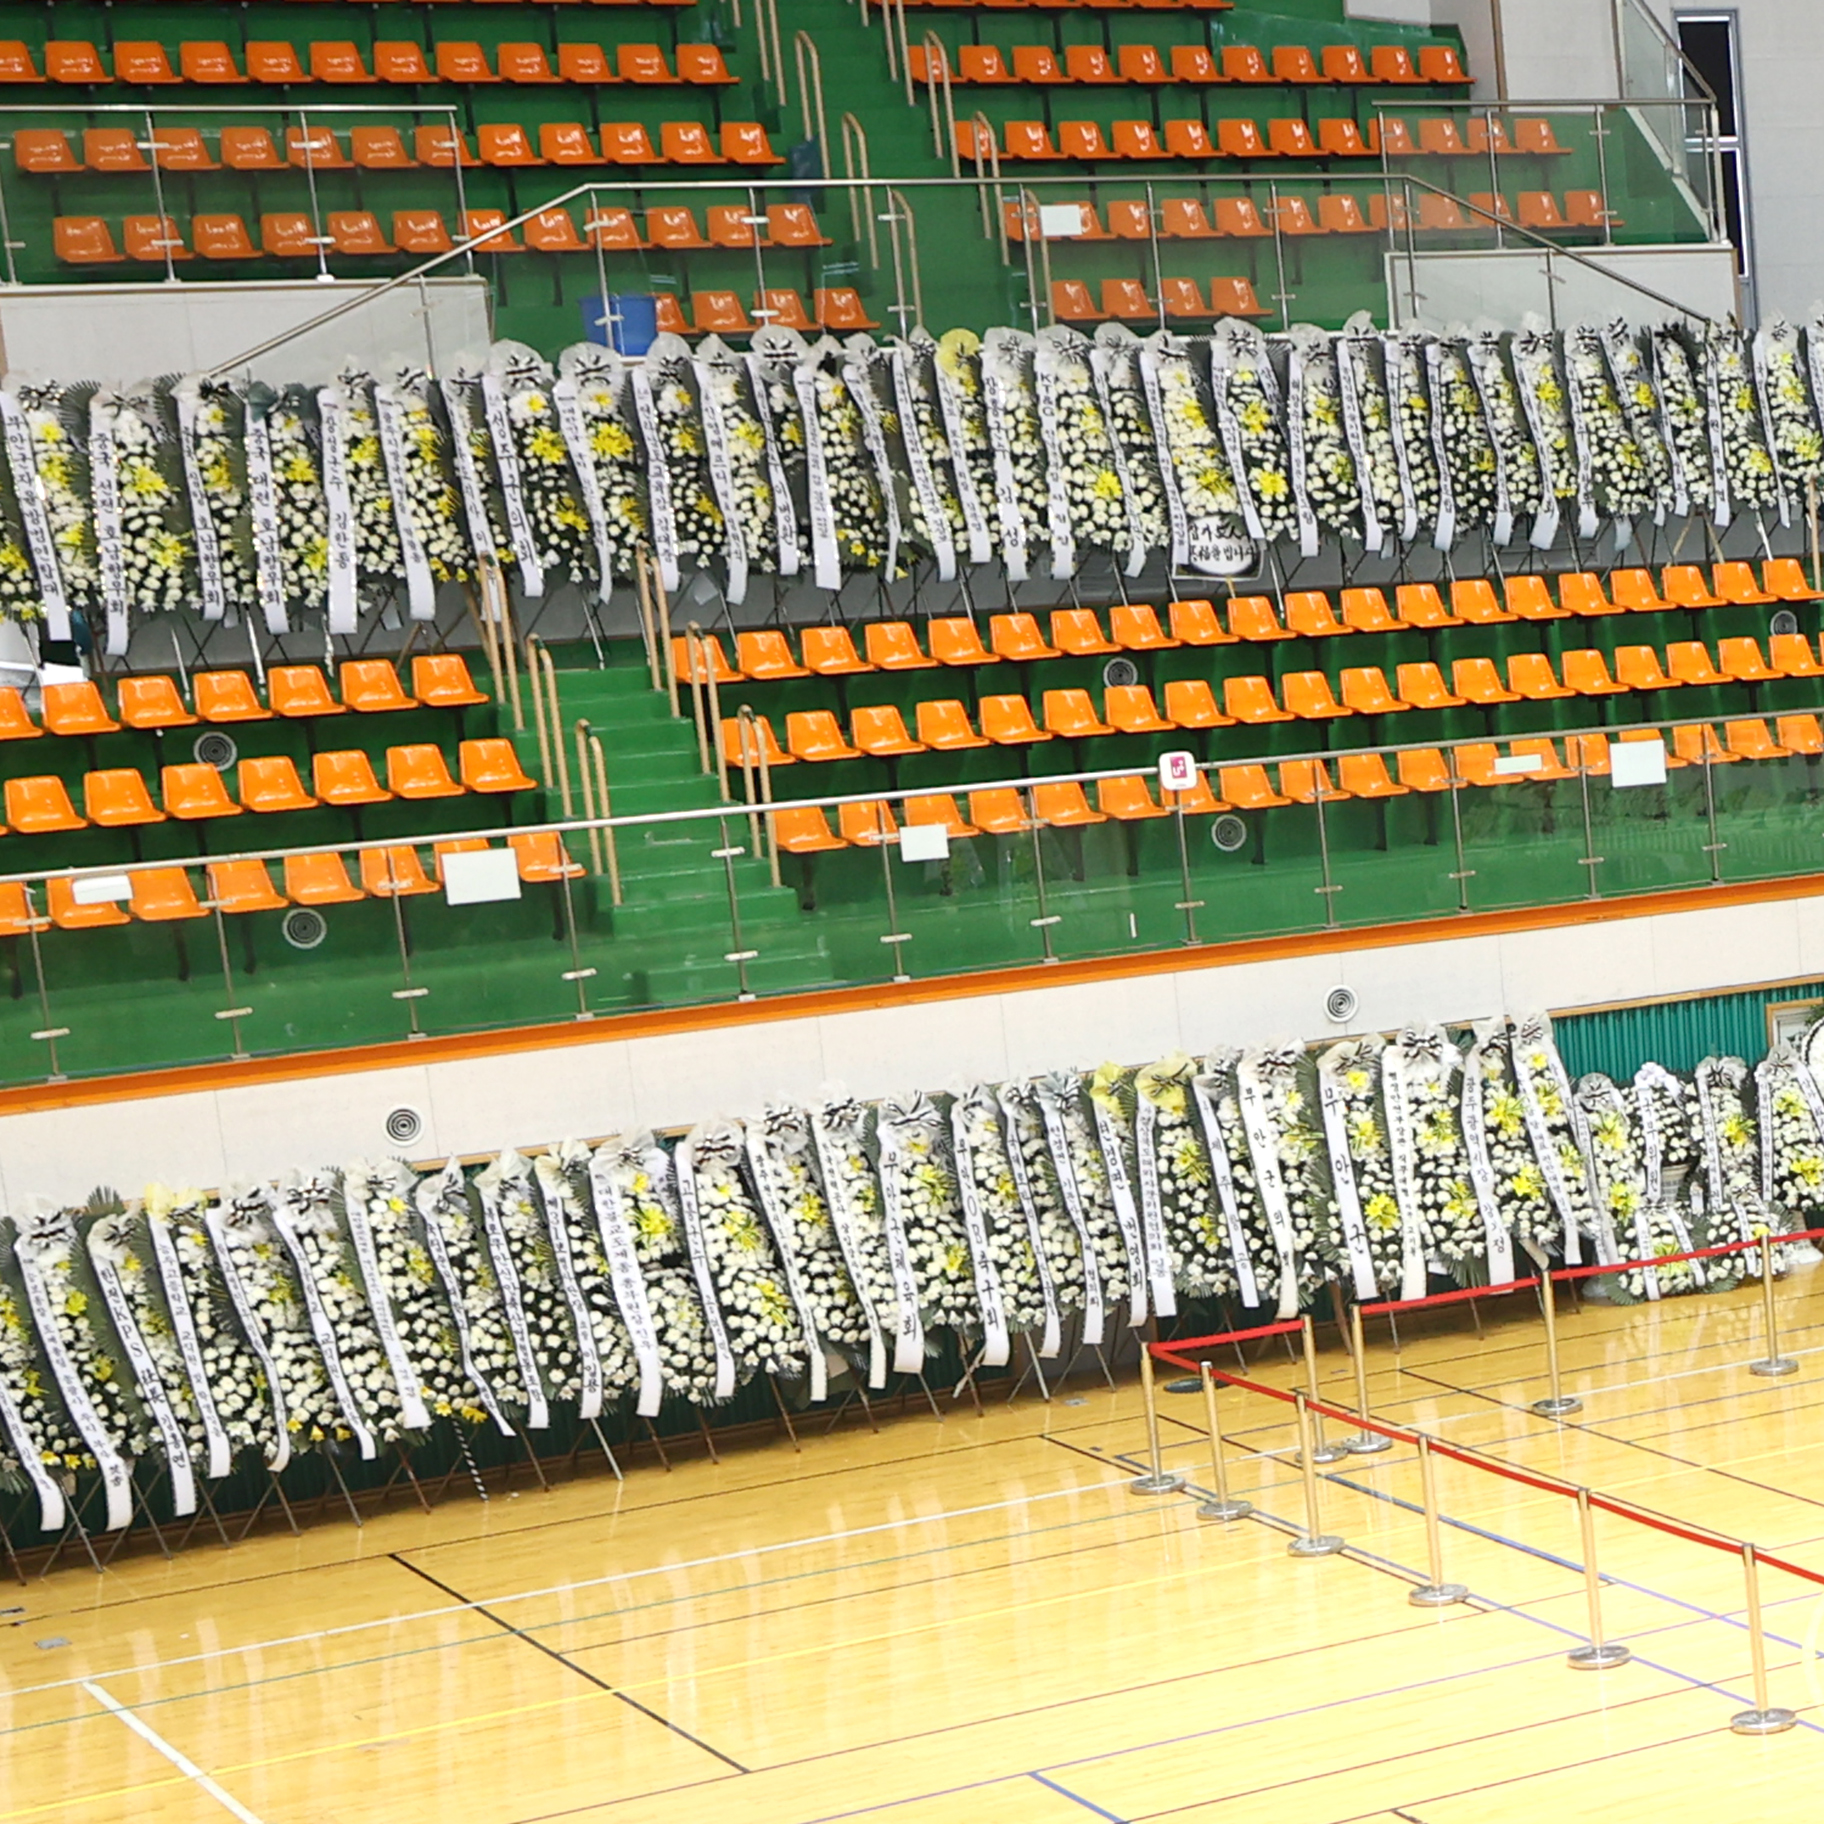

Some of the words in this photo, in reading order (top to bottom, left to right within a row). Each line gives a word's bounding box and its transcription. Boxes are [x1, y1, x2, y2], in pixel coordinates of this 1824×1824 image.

[984, 376, 1010, 460] 장흥군수
[1039, 372, 1054, 417] KT&G
[94, 433, 111, 467] 중국
[252, 428, 267, 461] 중국
[253, 471, 269, 507] 대련
[490, 410, 534, 566] 성주군의회
[102, 525, 123, 616] 호남향우회
[195, 515, 222, 606] 호남향우회
[259, 517, 283, 605] 호남향우회
[1243, 1086, 1290, 1266] 부안군의회
[1323, 1088, 1366, 1256] 부안군
[1463, 1077, 1488, 1182] 광주광역시장
[1484, 1202, 1505, 1253] 강기정
[598, 1185, 631, 1274] 대한불교조계종
[680, 1179, 705, 1266] 고흥군수
[101, 1268, 142, 1357] 한전KPS
